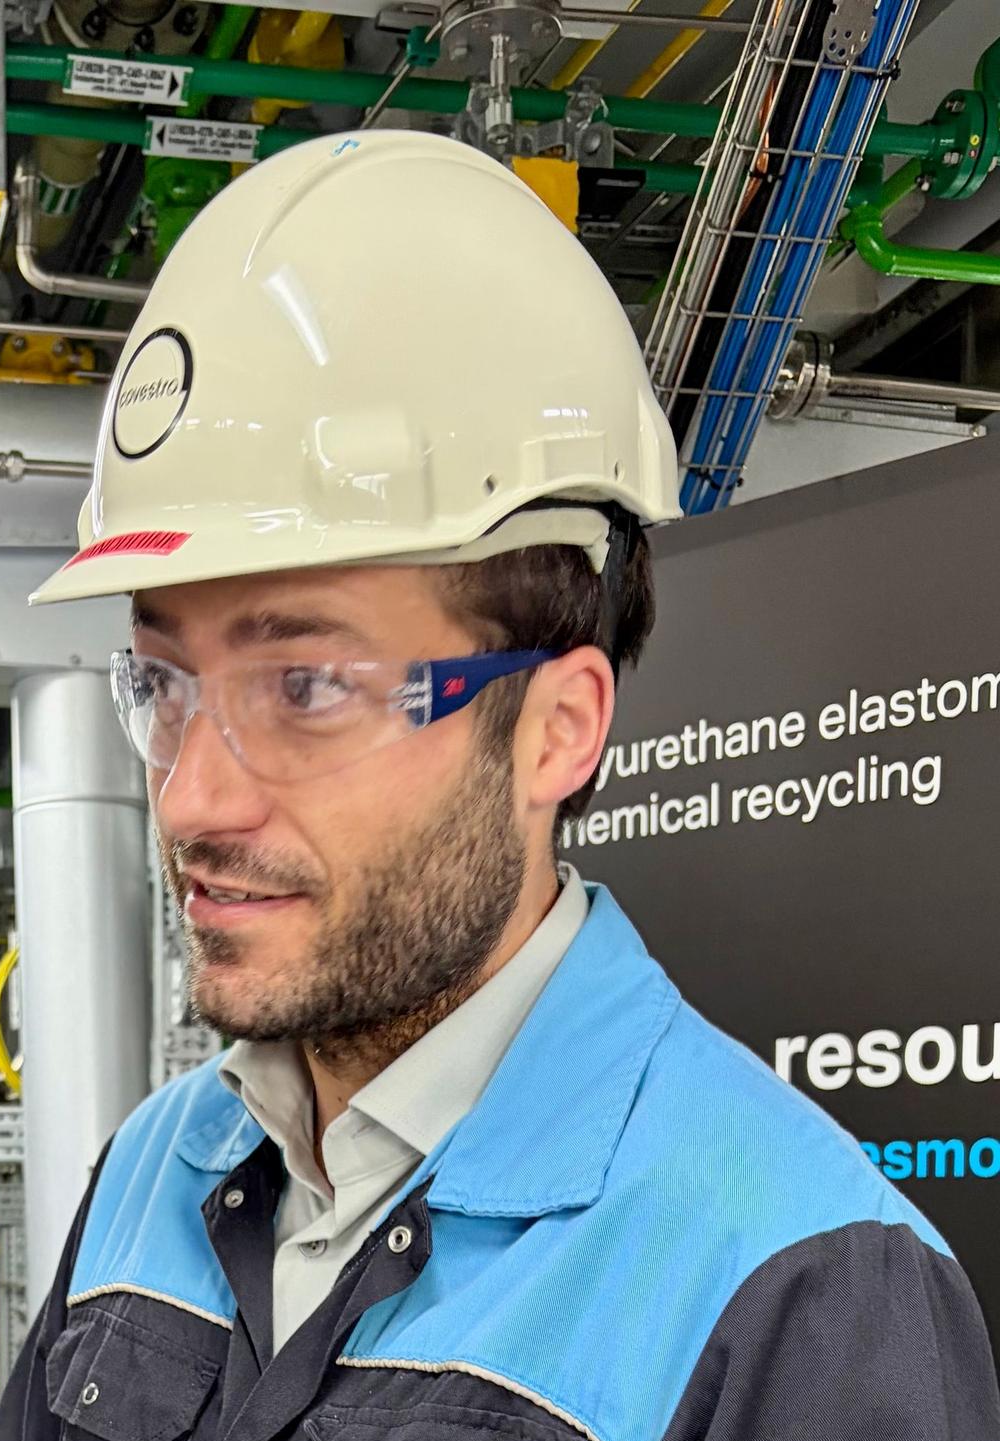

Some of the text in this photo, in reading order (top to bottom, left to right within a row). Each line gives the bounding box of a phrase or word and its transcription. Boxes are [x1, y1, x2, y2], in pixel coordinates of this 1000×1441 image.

[119, 377, 179, 408] covestro
[595, 672, 1000, 791] yurethane elastom
[732, 755, 942, 823] recycling
[774, 1022, 1000, 1091] resou
